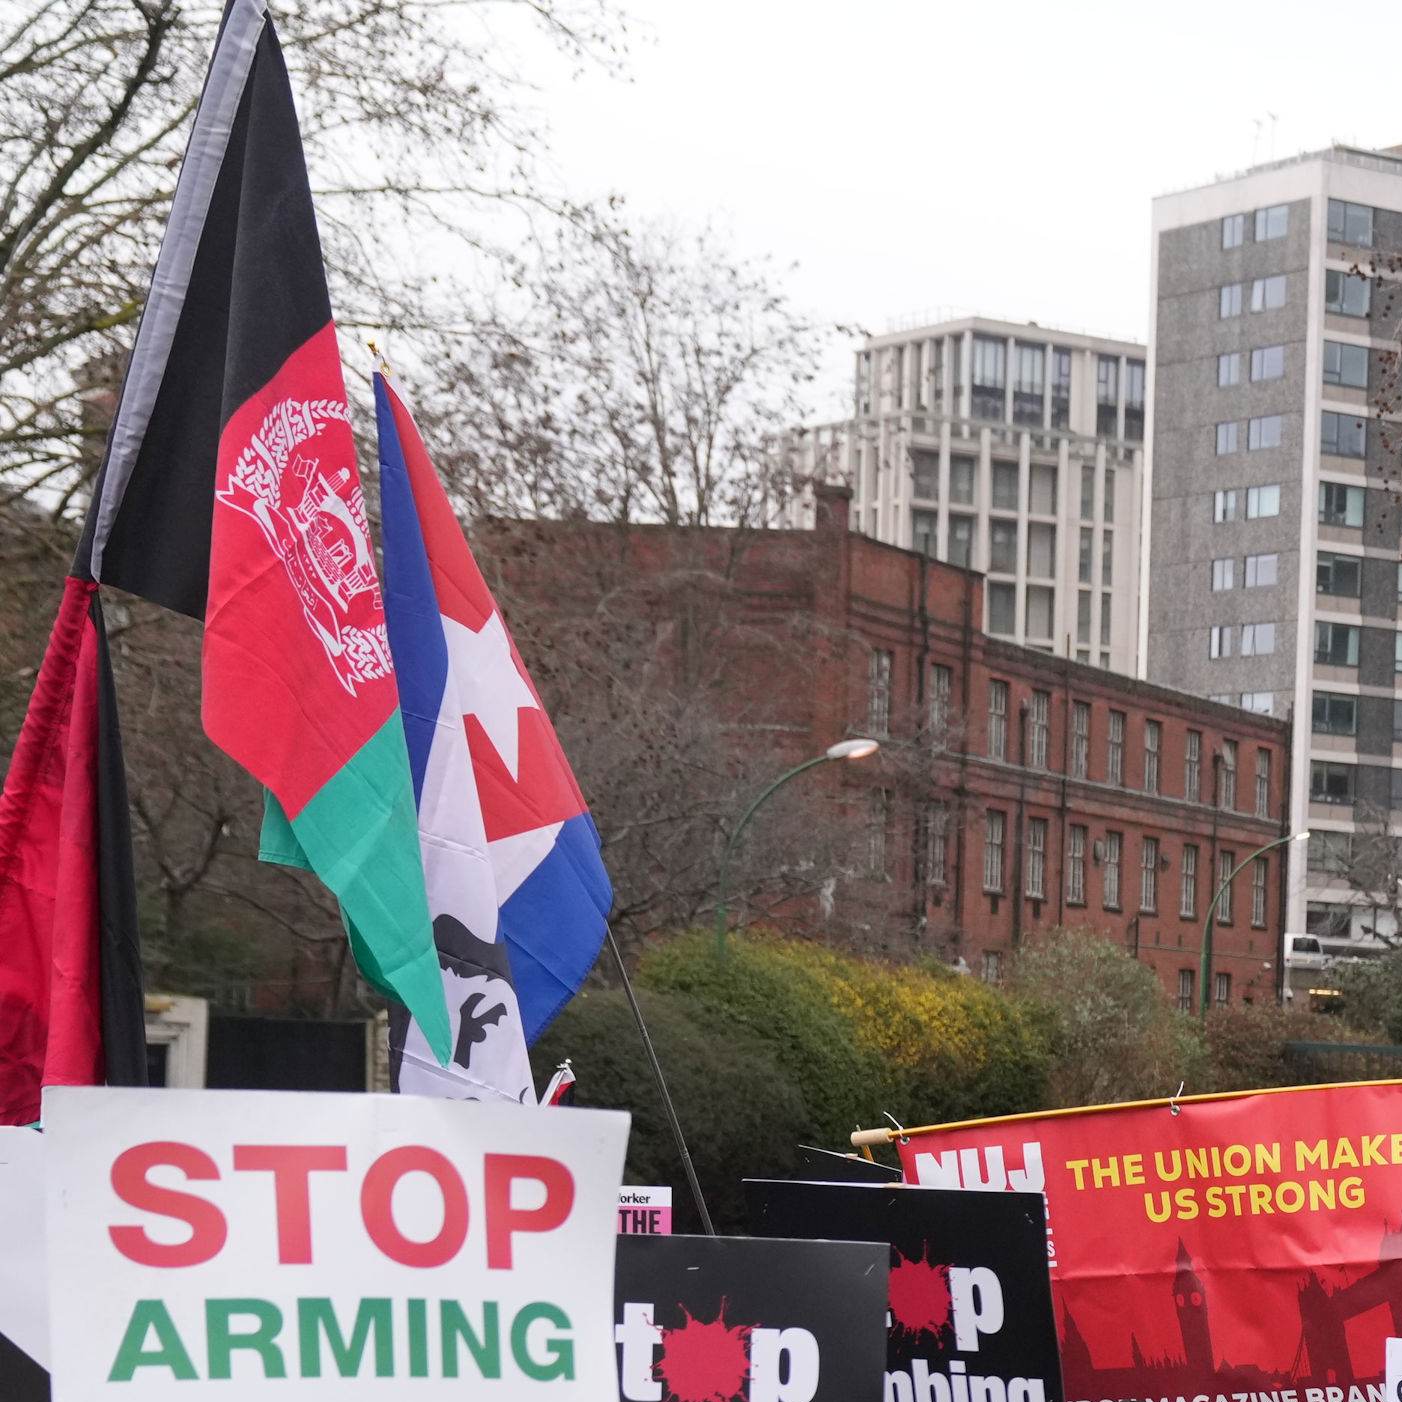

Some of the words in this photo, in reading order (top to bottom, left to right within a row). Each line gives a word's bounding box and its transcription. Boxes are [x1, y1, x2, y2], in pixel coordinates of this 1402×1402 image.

[914, 1141, 1046, 1192] NUJ
[1066, 1153, 1146, 1191] THE
[1155, 1143, 1282, 1181] UNION
[108, 1140, 578, 1272] STOP
[618, 1210, 661, 1234] THE
[619, 1193, 651, 1203] orker
[1145, 1190, 1200, 1223] US
[1208, 1177, 1367, 1218] STRONG
[105, 1296, 577, 1384] ARMING
